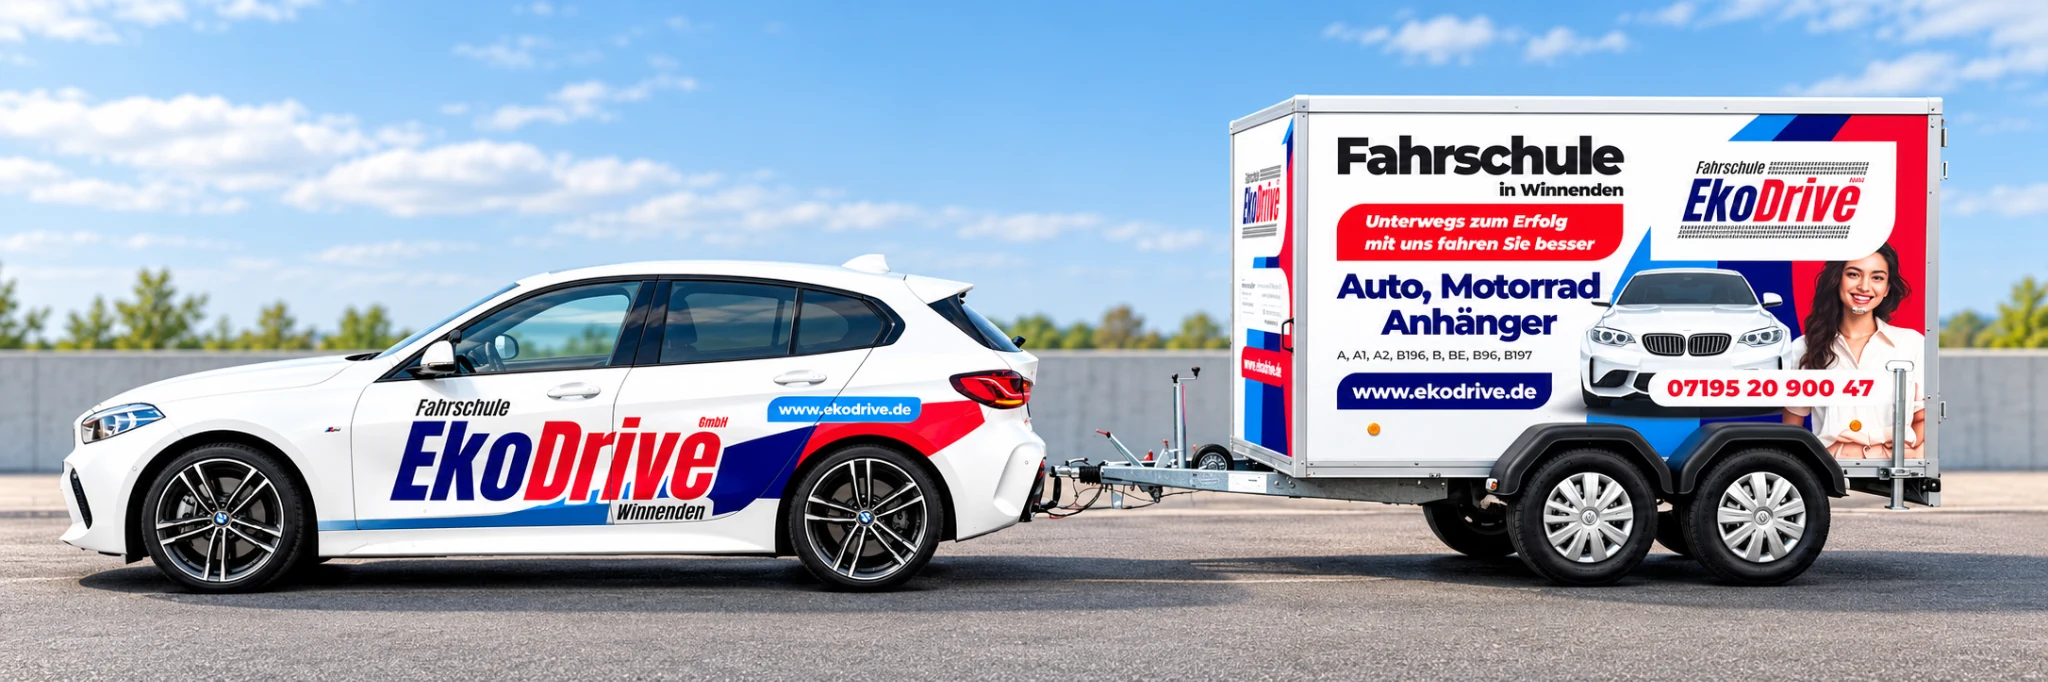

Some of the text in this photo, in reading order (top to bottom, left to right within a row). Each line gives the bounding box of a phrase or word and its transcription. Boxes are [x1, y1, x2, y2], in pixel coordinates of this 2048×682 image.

[1337, 135, 1625, 176] Fahrschule
[1695, 160, 1766, 175] Fahrschule
[1499, 181, 1624, 197] in Winnenden
[1682, 177, 1861, 223] EkoDrive
[1365, 213, 1568, 232] Unterwegs zum Erfolg
[1364, 235, 1596, 251] mit uns fahren Sie besser
[1336, 271, 1601, 305] Auto, Motorrad
[1381, 306, 1558, 343] Anhänger
[1336, 350, 1533, 362] A, A1, A2, B196, B, BE, B96, B197
[1352, 382, 1537, 400] www.ekodrive.de
[1667, 379, 1875, 398] 07195 20 900 47
[415, 398, 511, 417] Fahrschule
[779, 402, 912, 416] www.ekodrive.de
[698, 416, 729, 428] GmbH
[390, 417, 721, 501] EkoDrive
[616, 502, 706, 521] Winnenden
